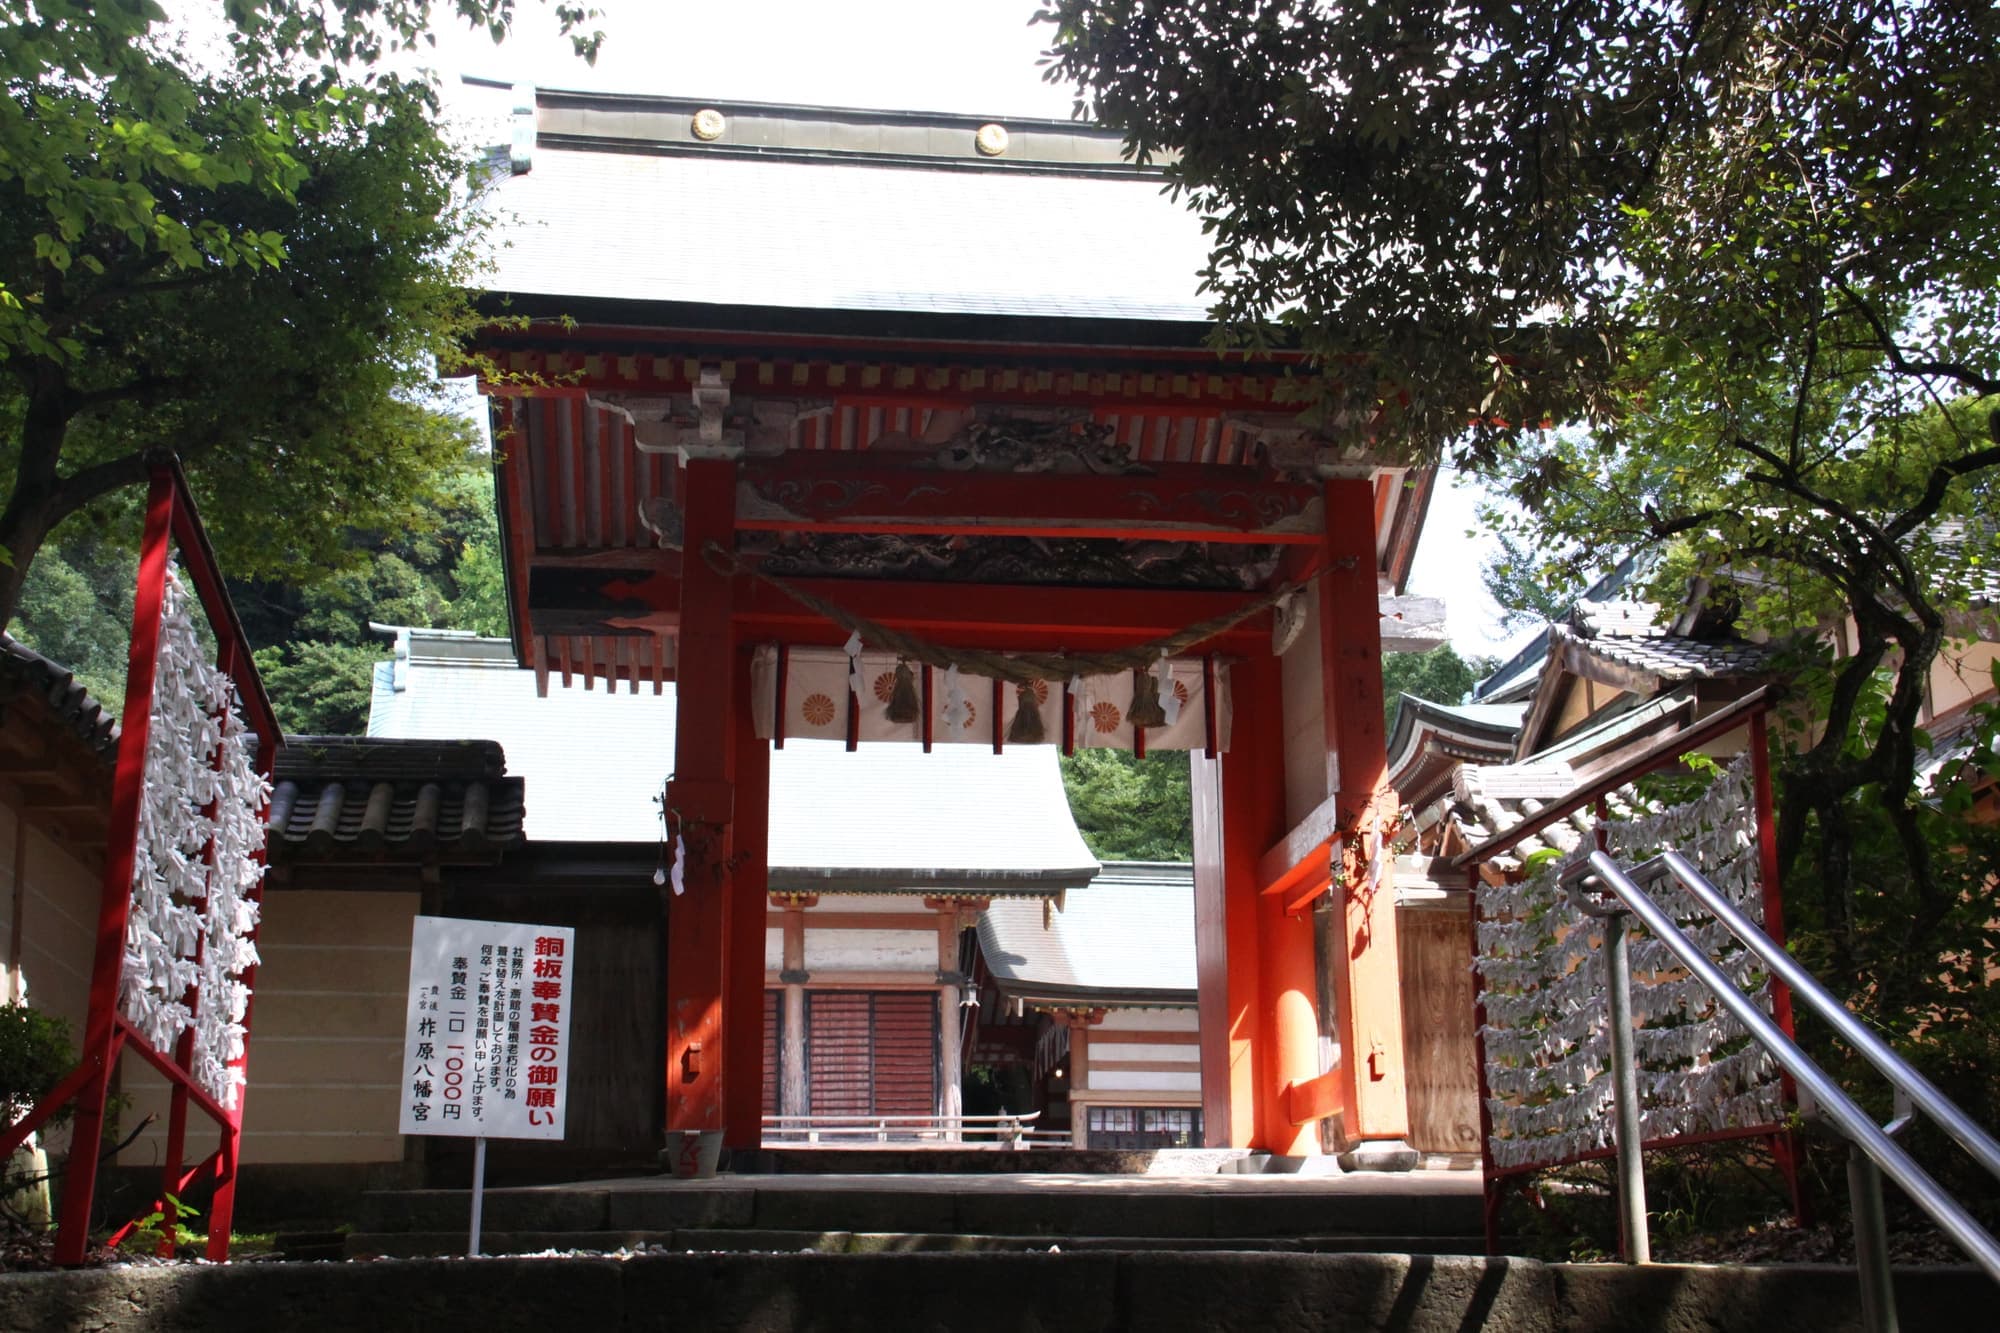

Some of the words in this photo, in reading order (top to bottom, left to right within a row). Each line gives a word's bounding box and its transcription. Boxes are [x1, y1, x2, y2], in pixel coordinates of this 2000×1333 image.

[451, 956, 468, 1000] 奉賛金
[412, 1017, 435, 1121] 柞原八幡宮
[526, 936, 565, 1126] 銅板奉賛金の御願い
